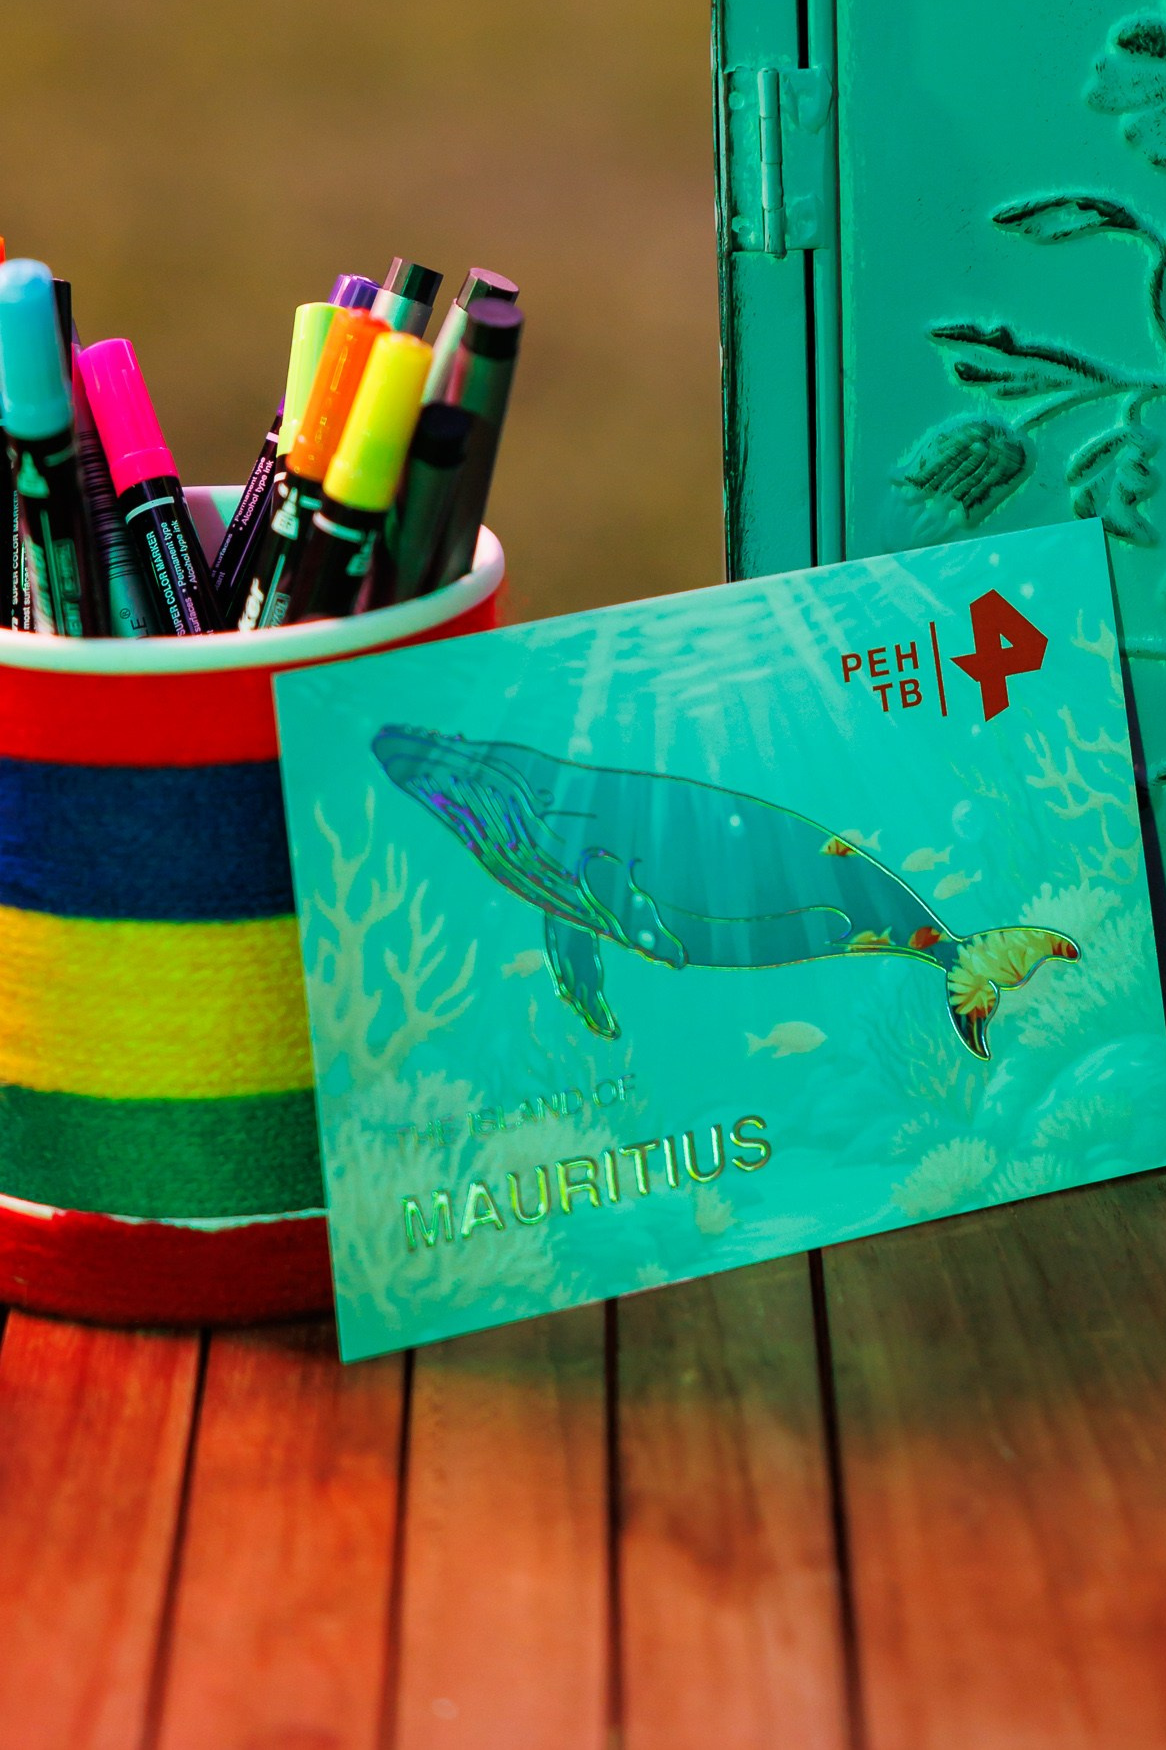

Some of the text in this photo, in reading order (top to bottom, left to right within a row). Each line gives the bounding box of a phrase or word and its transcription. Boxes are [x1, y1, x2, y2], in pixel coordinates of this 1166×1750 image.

[254, 457, 266, 475] type
[241, 494, 259, 526] Alcohol
[255, 474, 268, 494] type
[160, 522, 186, 588] Permanent type
[171, 519, 198, 583] Alcohol type ink
[146, 530, 186, 637] SUPER COLOR MARKER
[185, 597, 201, 633] surfaces
[465, 1088, 584, 1137] ISLAND
[592, 1073, 636, 1109] OF
[402, 1114, 772, 1250] MAURITIUS
